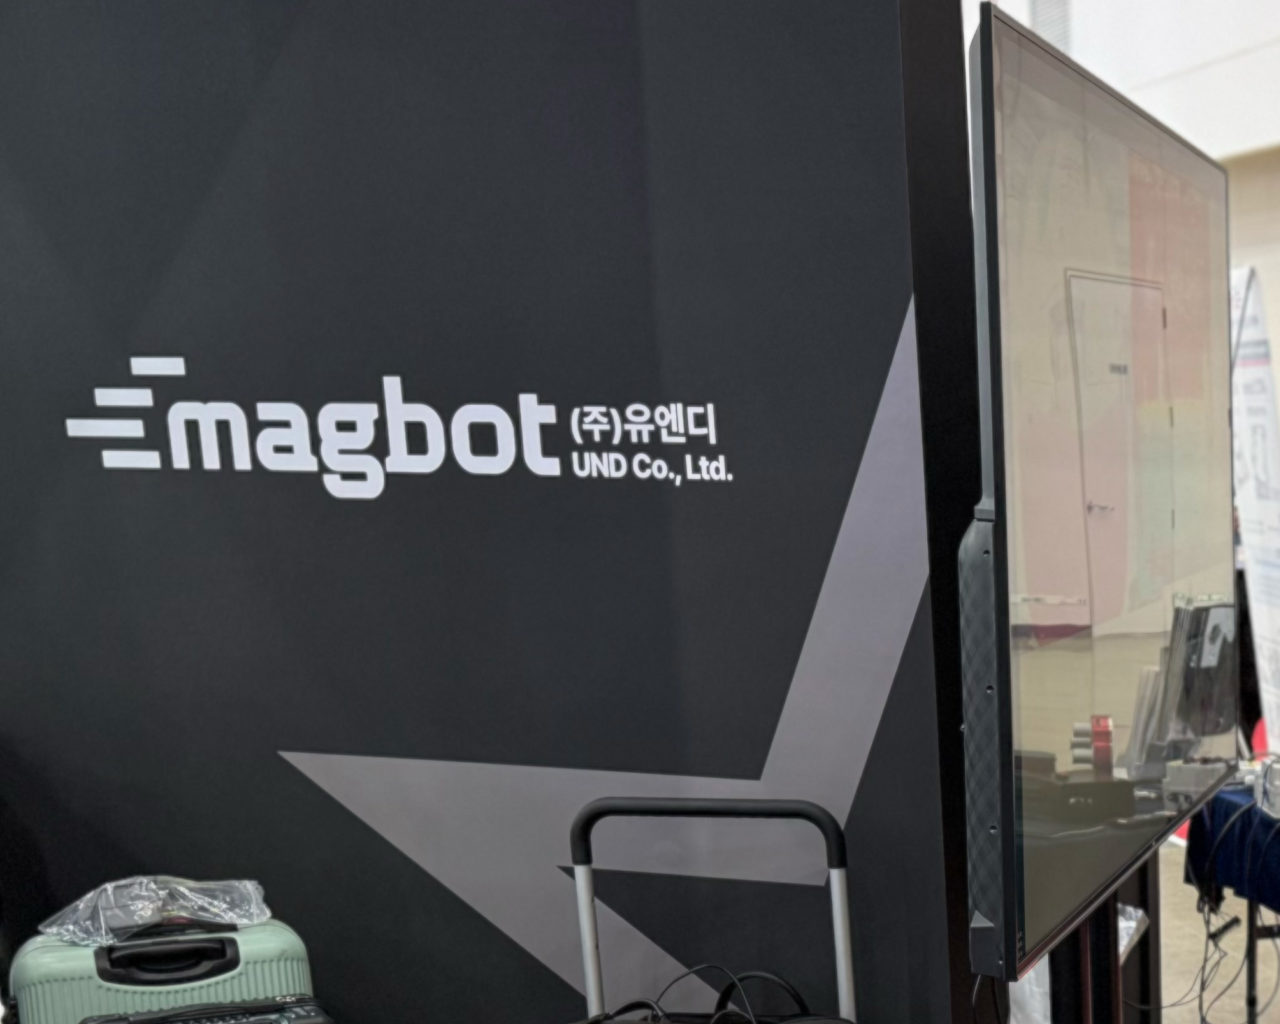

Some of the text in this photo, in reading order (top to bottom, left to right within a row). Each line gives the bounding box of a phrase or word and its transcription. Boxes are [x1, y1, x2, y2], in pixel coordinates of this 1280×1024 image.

[570, 402, 717, 445] (주)유엔디
[571, 451, 734, 486] UND Co., Ltd.
